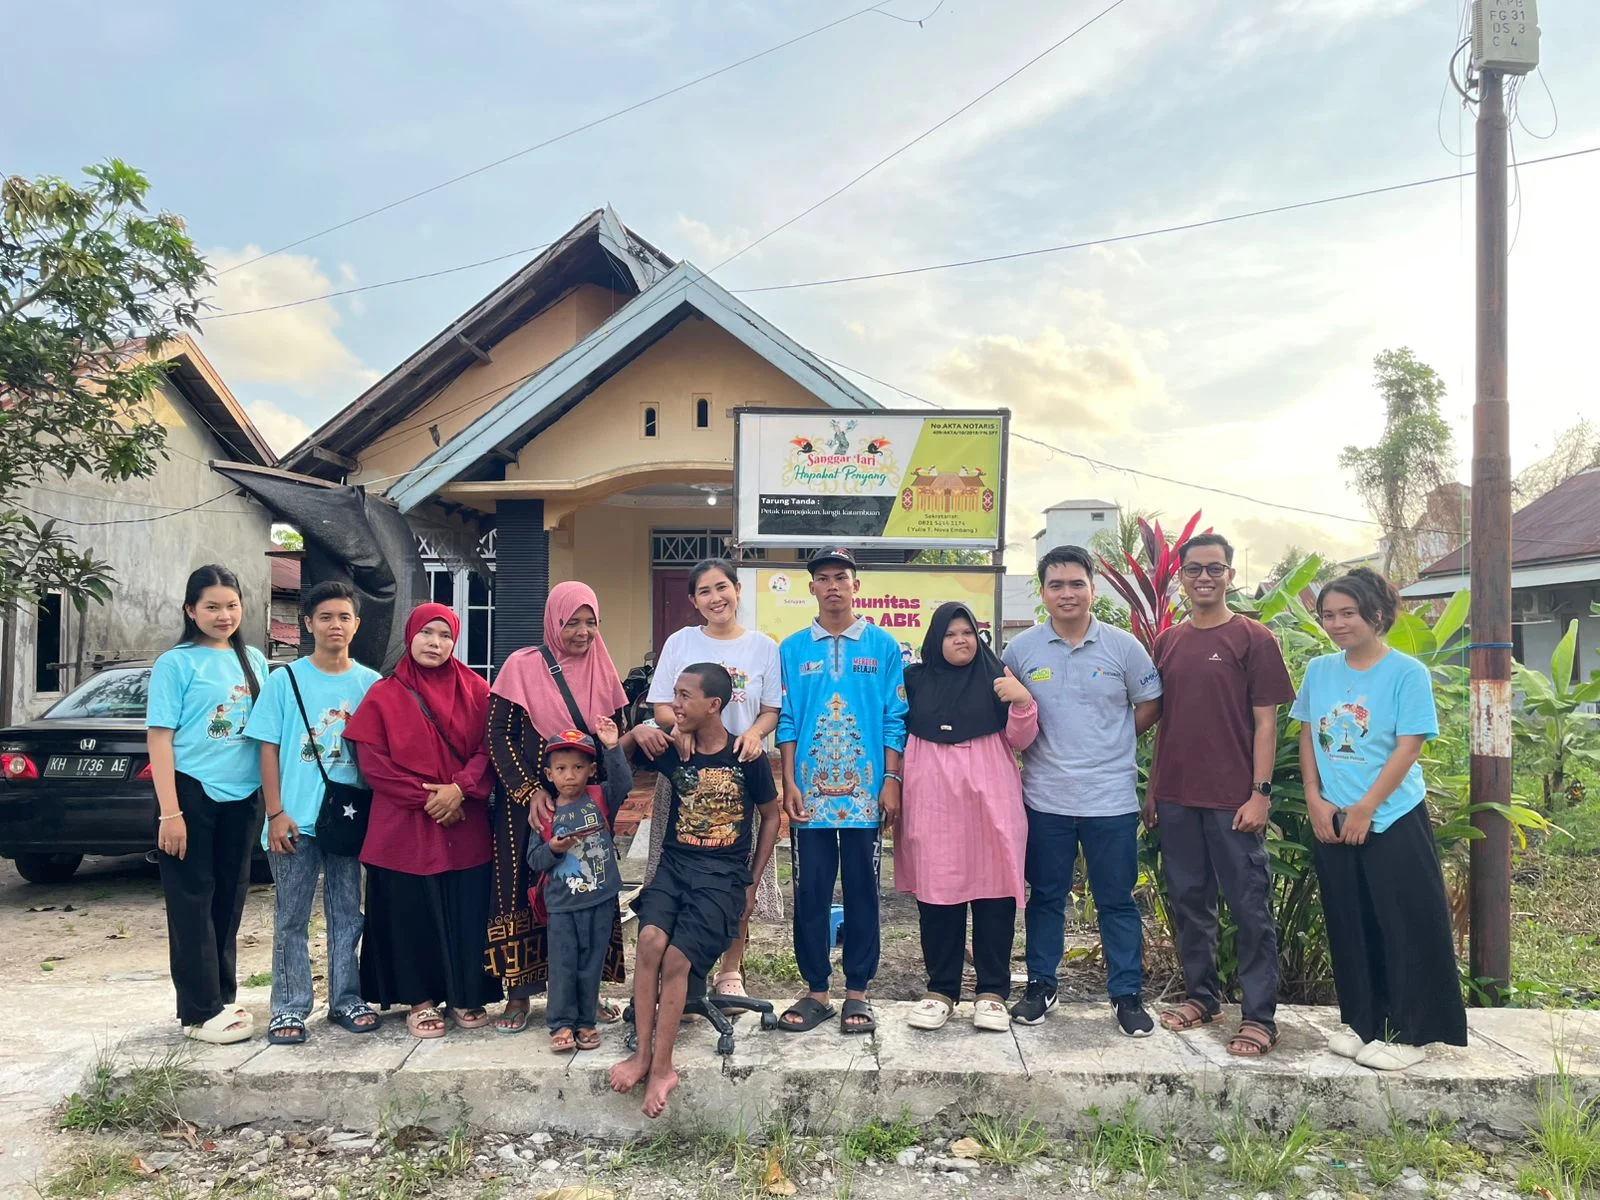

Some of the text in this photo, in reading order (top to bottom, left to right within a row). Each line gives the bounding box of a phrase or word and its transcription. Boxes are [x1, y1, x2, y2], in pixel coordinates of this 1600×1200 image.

[807, 454, 876, 466] Sanggar Tari
[841, 465, 887, 486] Penyang
[879, 612, 921, 627] ABK
[50, 758, 127, 772] KH 1736 AE
